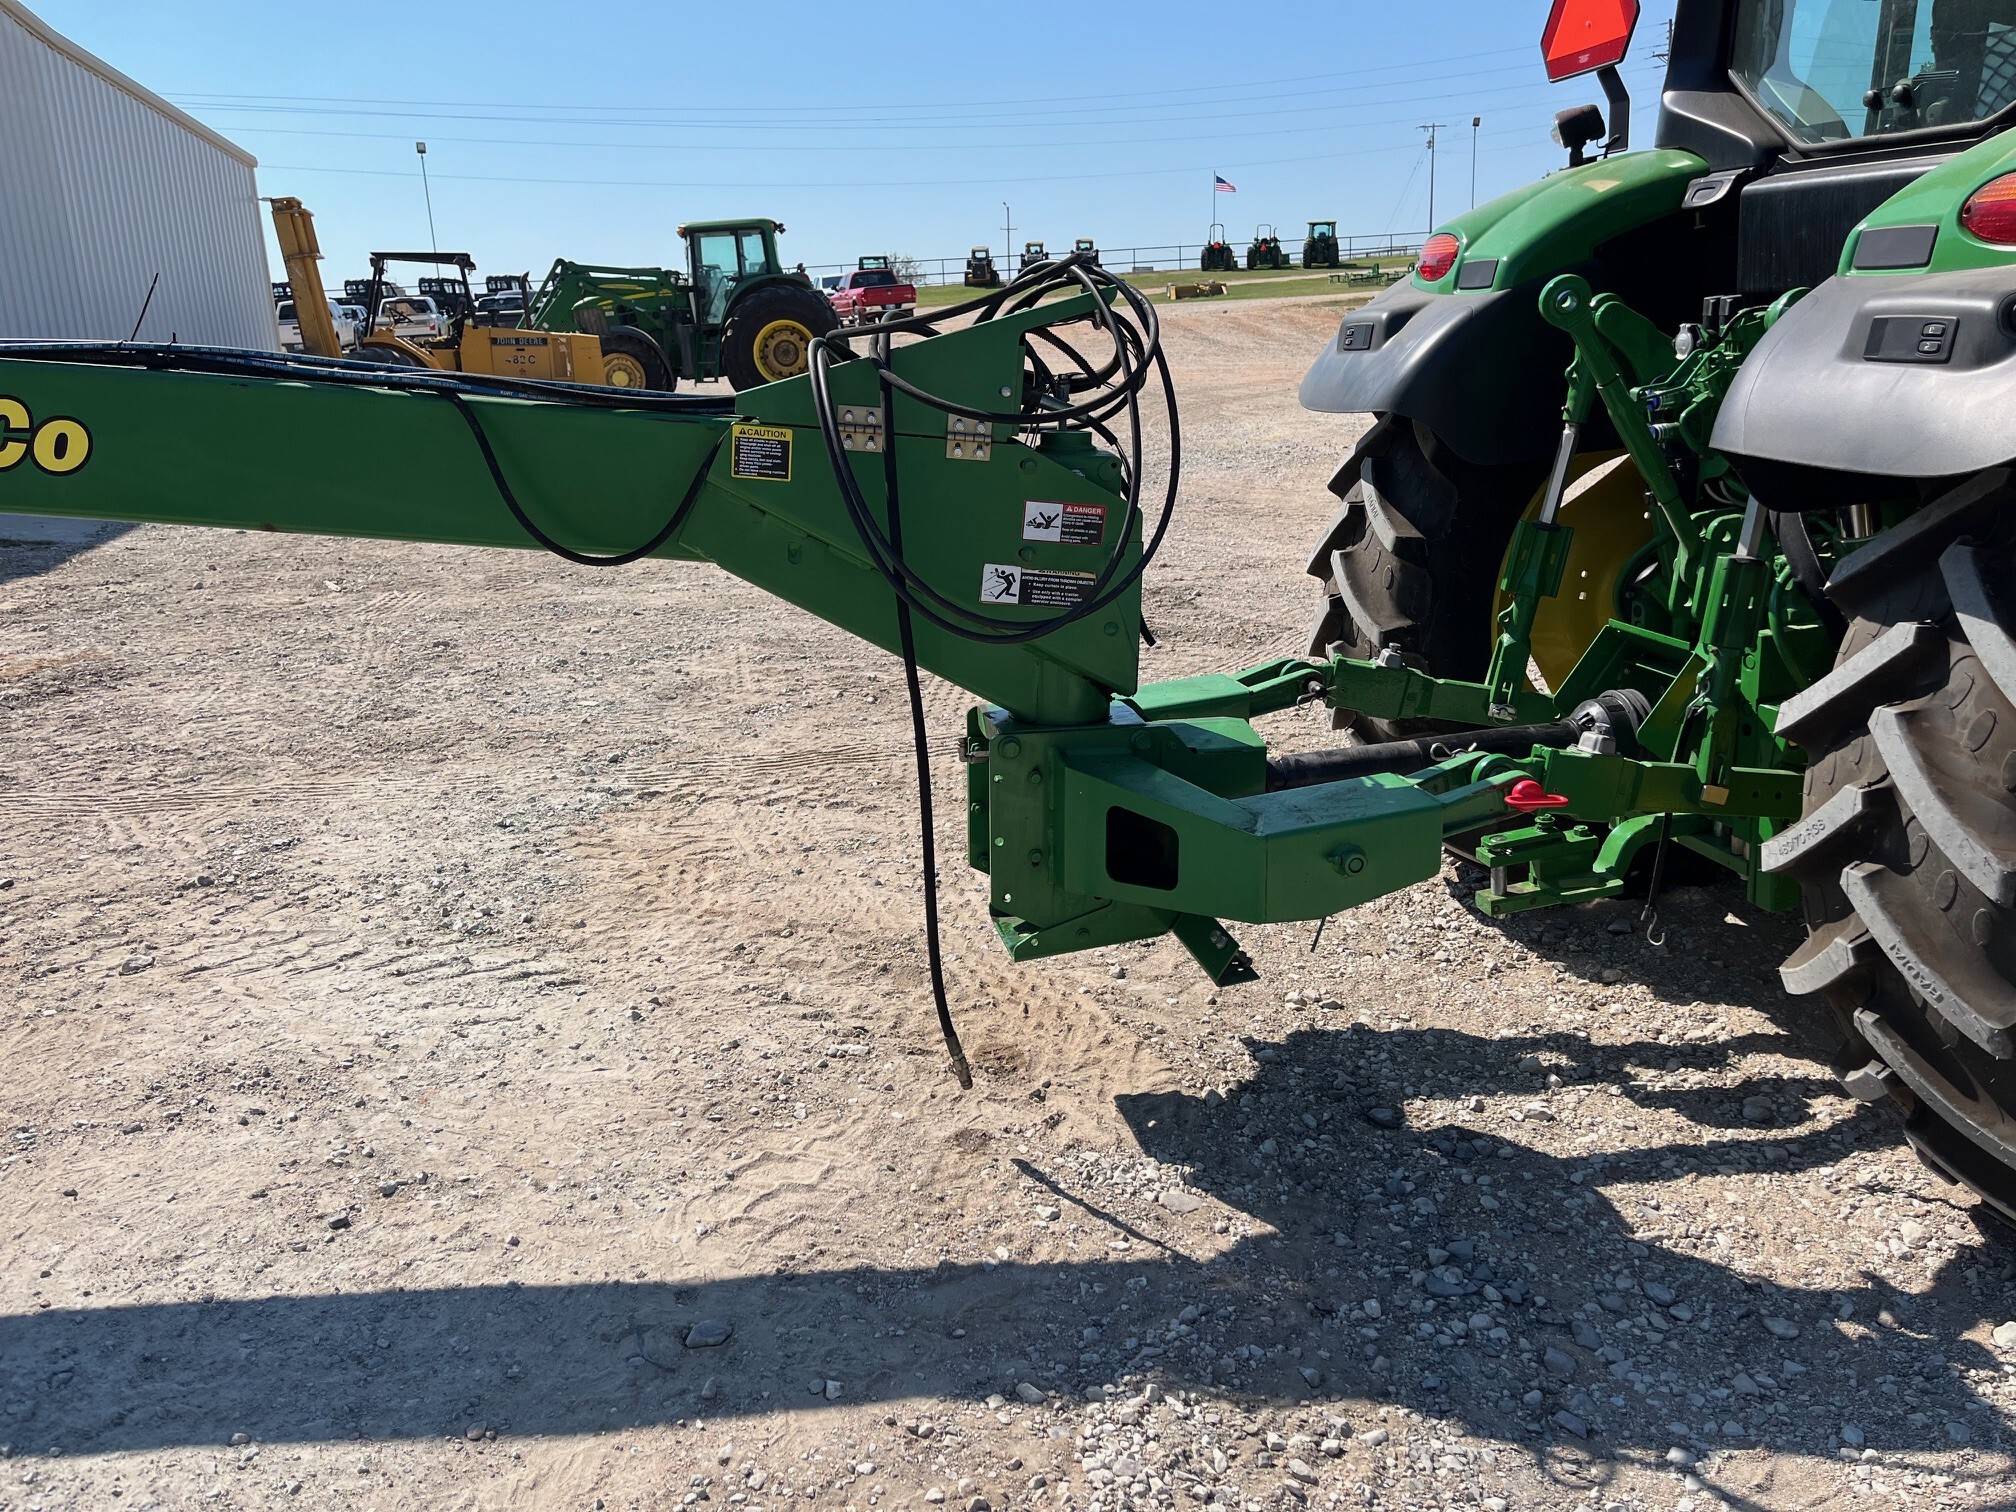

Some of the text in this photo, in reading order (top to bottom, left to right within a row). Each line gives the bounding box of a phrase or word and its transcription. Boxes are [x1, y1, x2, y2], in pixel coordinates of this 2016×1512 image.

[496, 337, 543, 345] JOHN DEERE
[747, 428, 787, 438] CAUTION
[1073, 506, 1102, 515] DANGER
